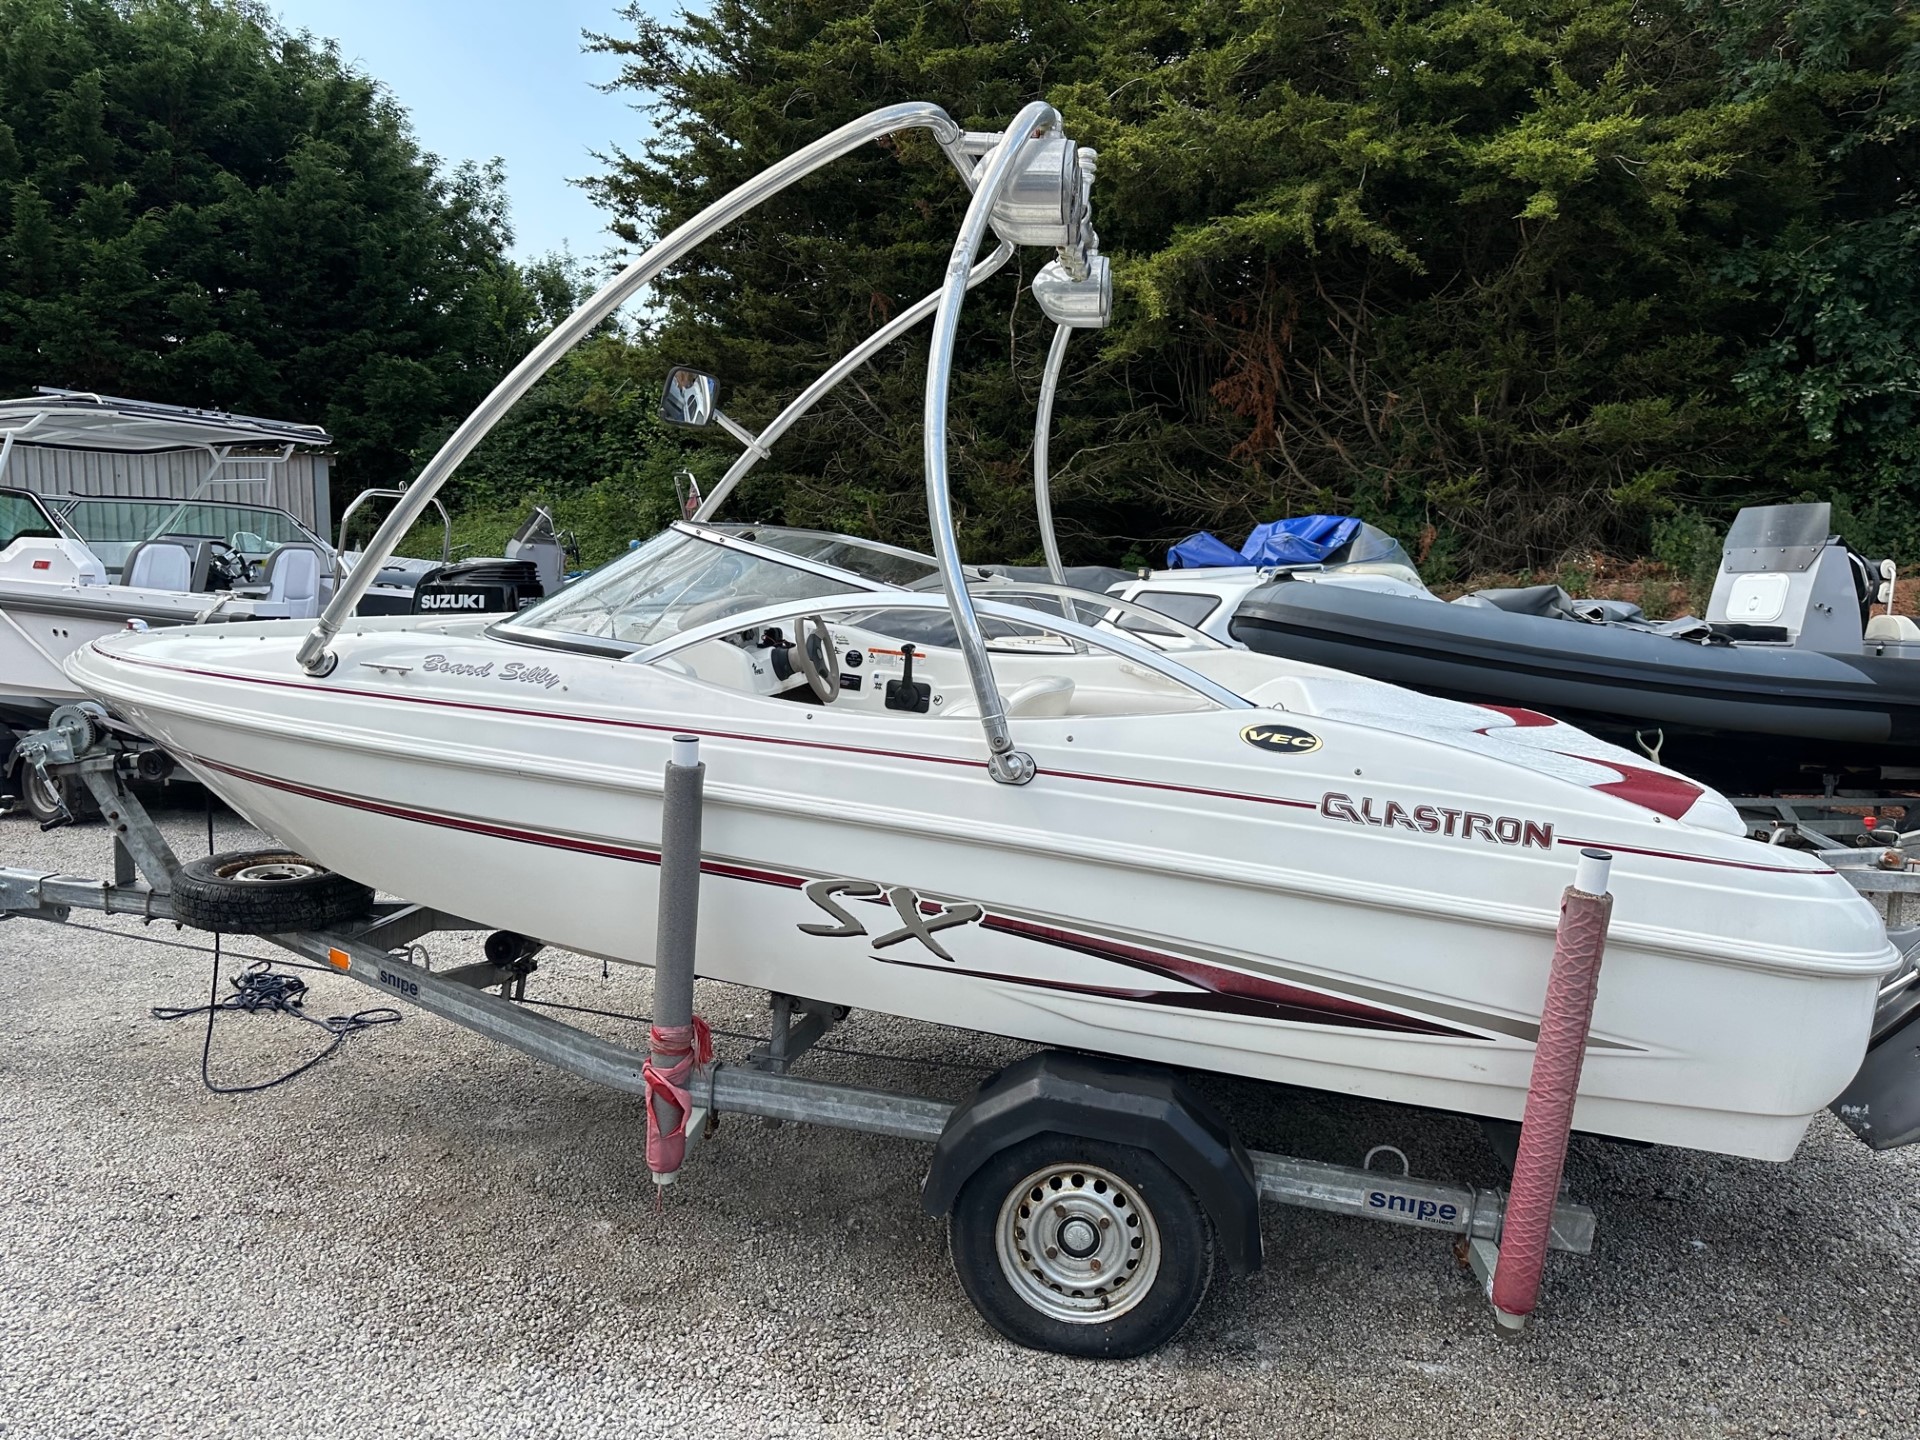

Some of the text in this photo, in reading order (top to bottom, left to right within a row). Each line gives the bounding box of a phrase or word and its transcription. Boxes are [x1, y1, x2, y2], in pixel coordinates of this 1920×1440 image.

[421, 594, 485, 609] SUZUKI
[423, 654, 560, 690] Board Silly
[1248, 729, 1316, 747] VEC
[1320, 791, 1554, 851] GLASTRON
[796, 880, 983, 963] SX
[380, 970, 418, 996] snipe
[1368, 1191, 1457, 1221] snipe
